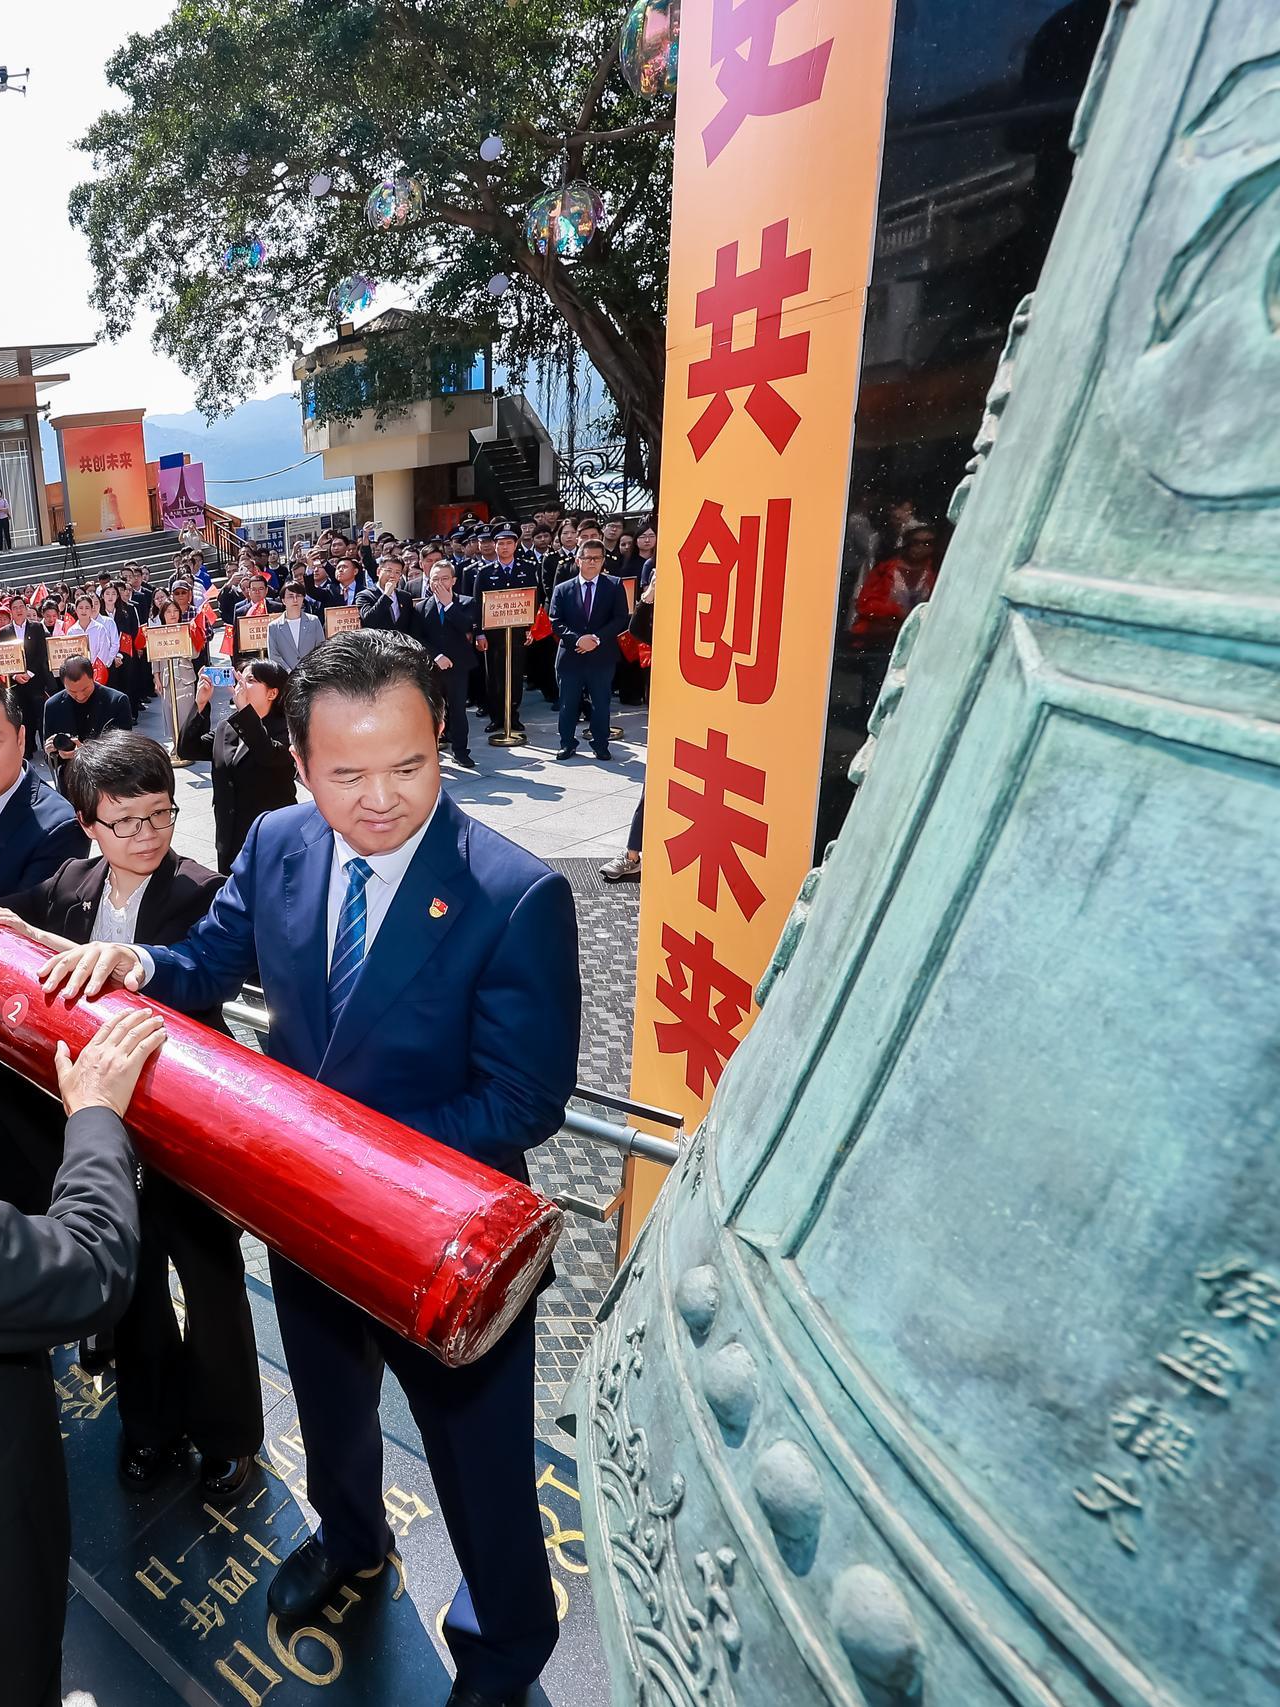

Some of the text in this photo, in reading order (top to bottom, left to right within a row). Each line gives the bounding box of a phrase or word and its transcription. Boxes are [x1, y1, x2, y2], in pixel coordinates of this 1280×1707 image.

[80, 452, 133, 474] 共创未来
[7, 1001, 22, 1023] 2
